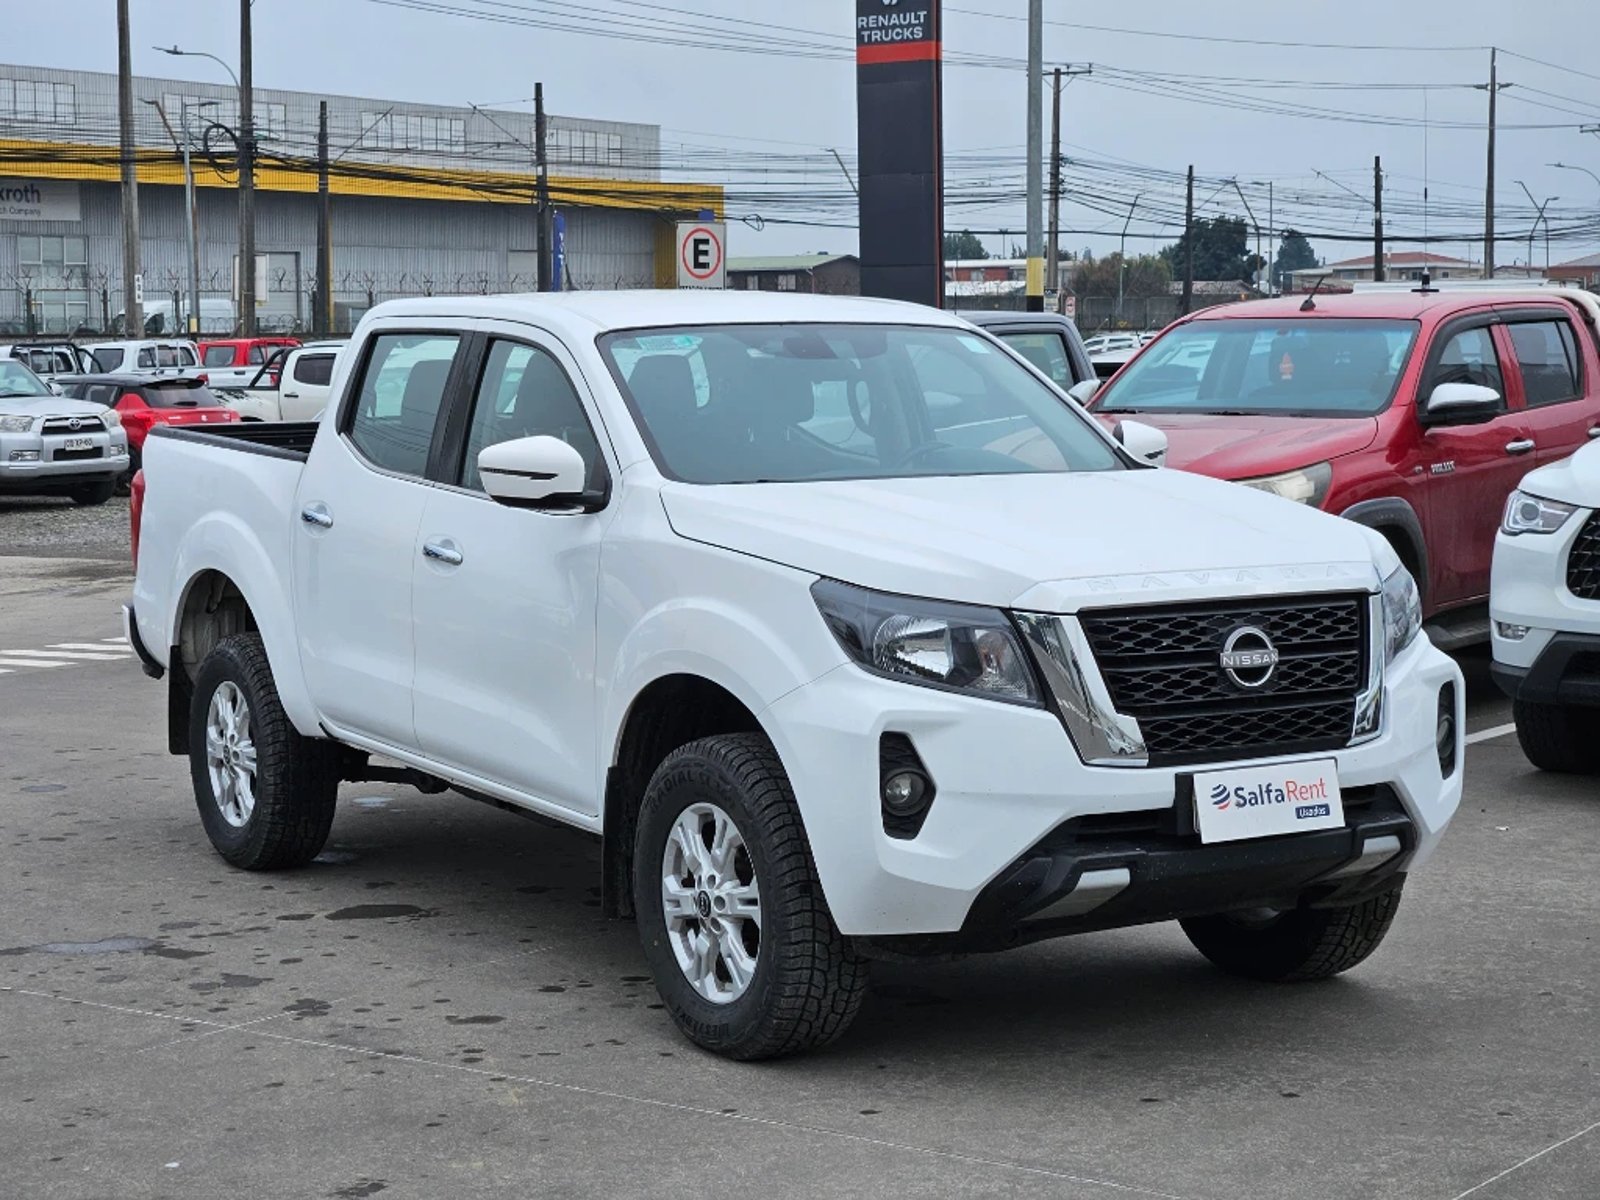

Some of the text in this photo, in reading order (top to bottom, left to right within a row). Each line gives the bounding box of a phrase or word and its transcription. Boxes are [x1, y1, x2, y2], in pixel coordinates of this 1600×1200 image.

[857, 10, 928, 29] RENAULT
[861, 26, 923, 43] TRUCKS
[9, 206, 41, 217] Company
[693, 238, 710, 270] E
[1086, 564, 1350, 592] NAVARA
[1222, 653, 1279, 667] NISSAN
[1234, 777, 1328, 809] SalfaRent
[1299, 807, 1327, 819] Usados
